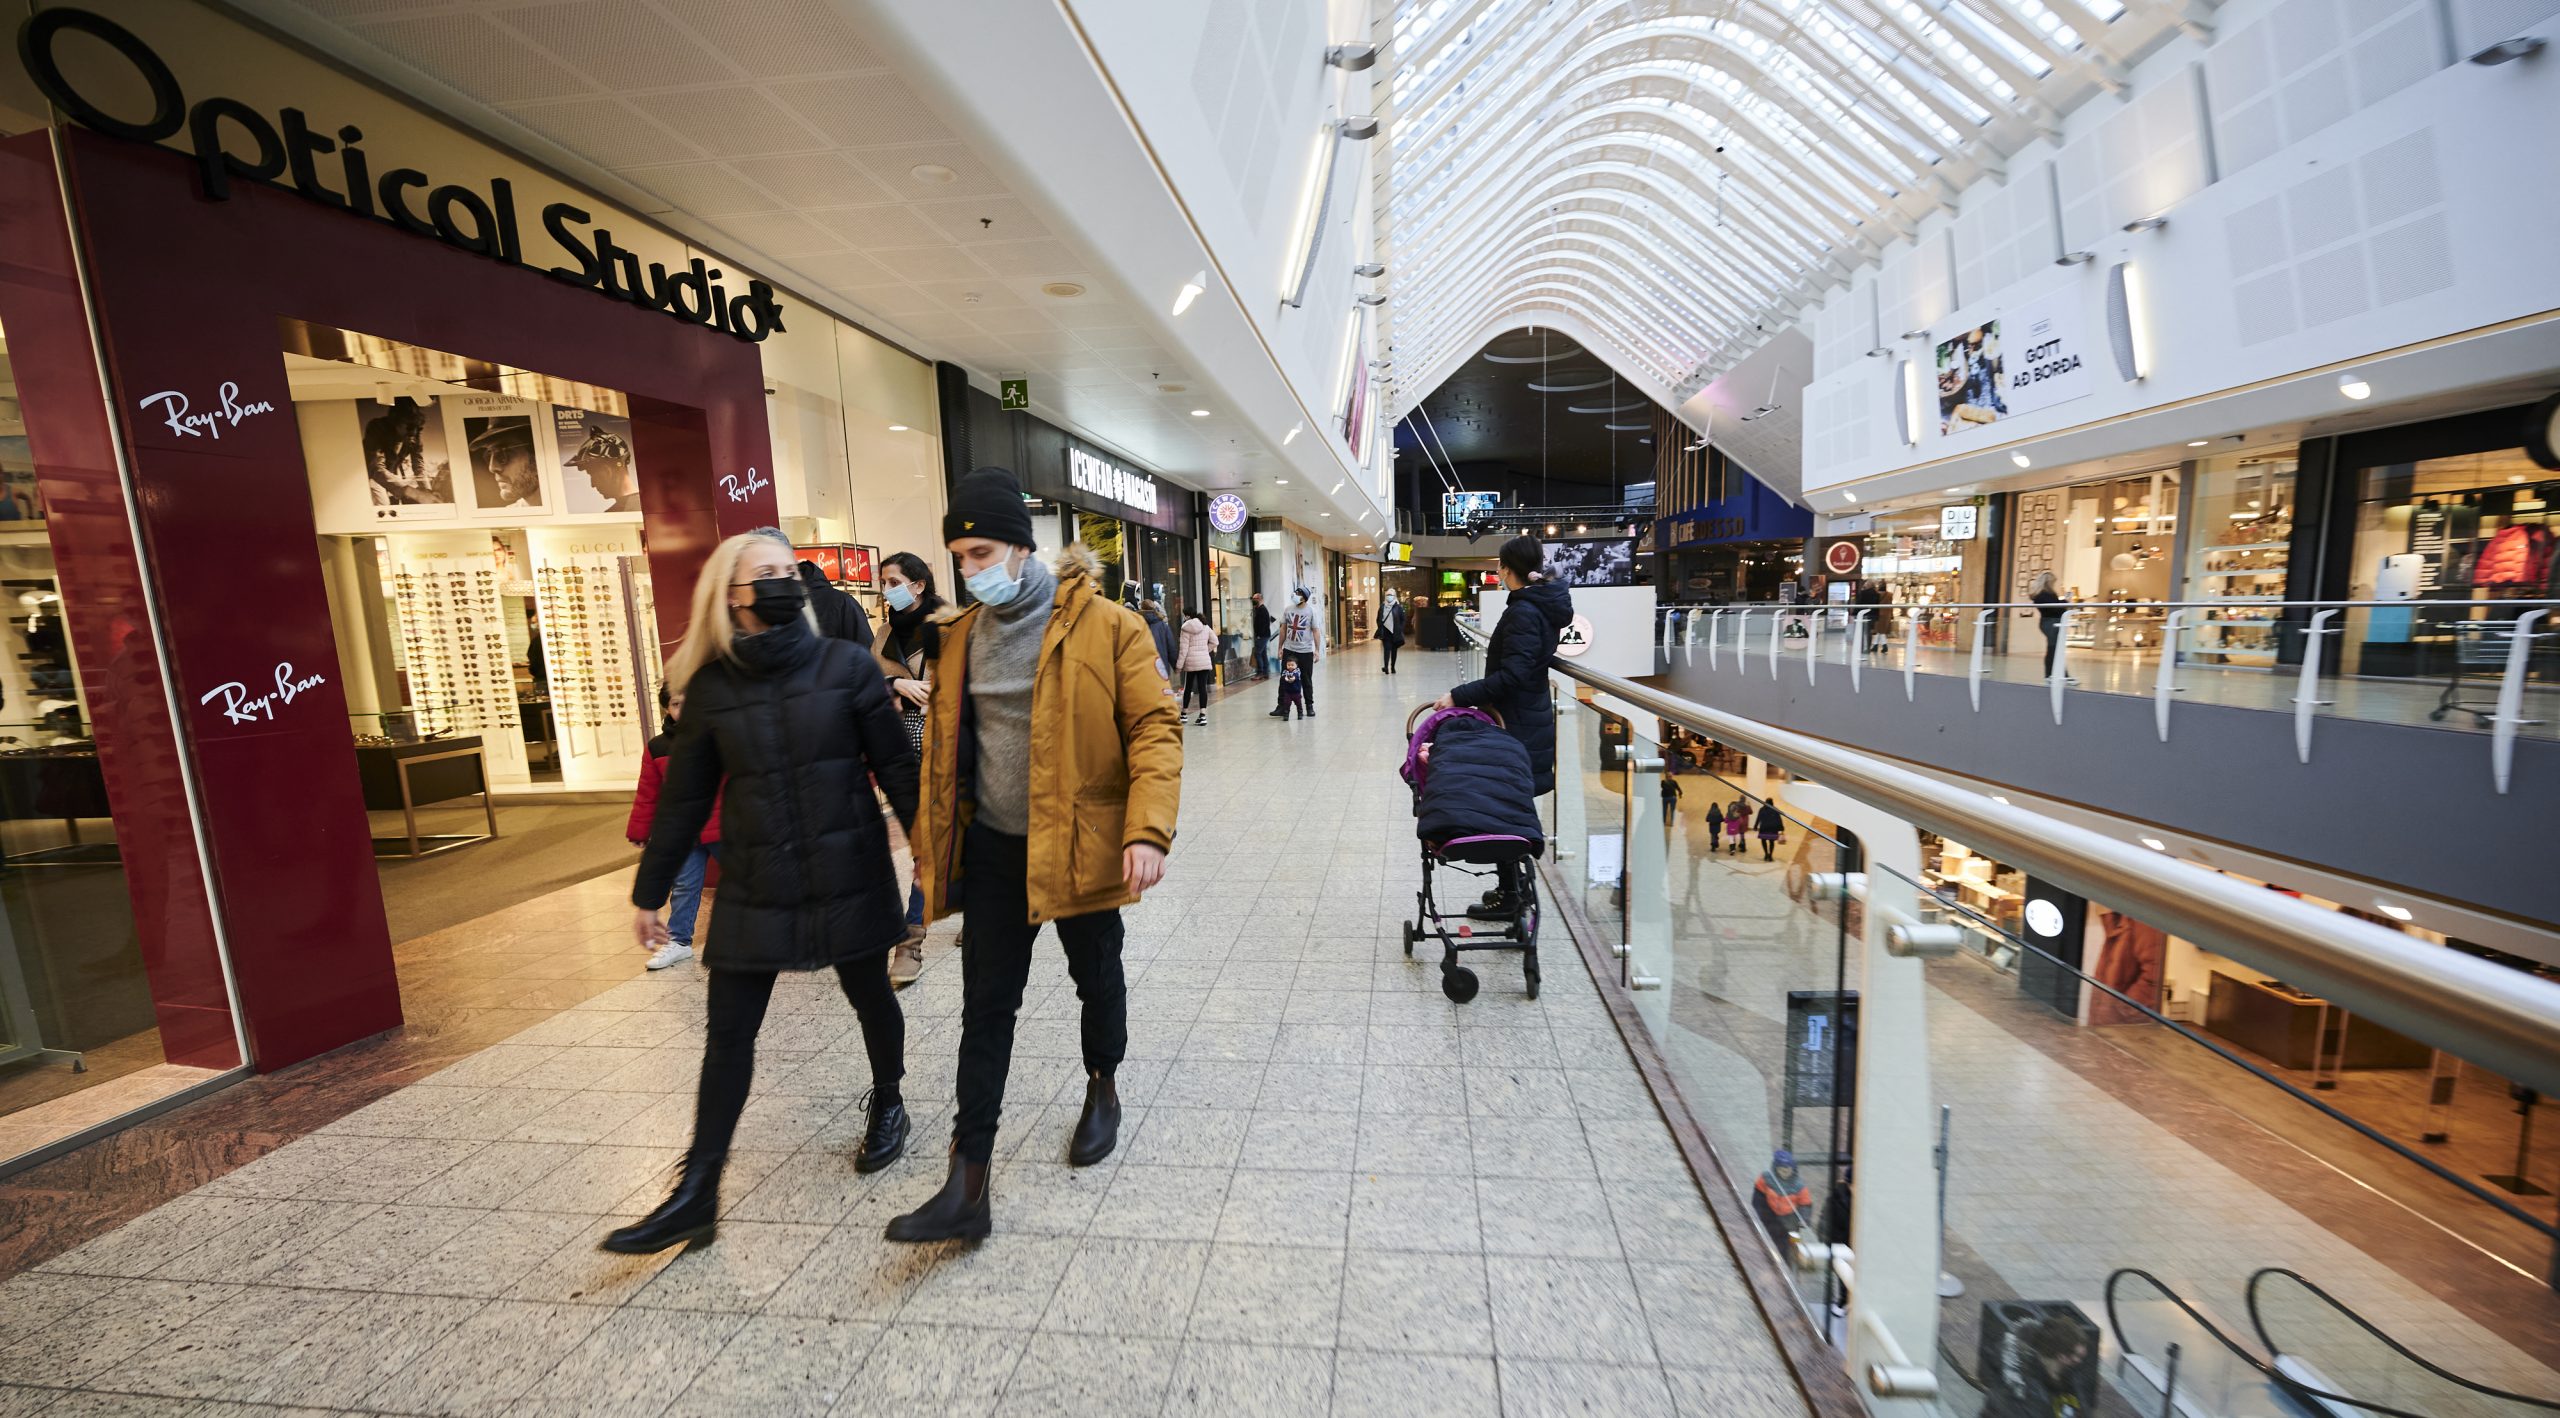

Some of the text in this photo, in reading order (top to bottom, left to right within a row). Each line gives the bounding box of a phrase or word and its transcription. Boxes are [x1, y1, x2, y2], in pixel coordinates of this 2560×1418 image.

[17, 8, 522, 264] Optical
[542, 203, 772, 342] Studio
[2026, 338, 2062, 363] GOTT
[1070, 447, 1114, 500] ICEWEAR
[570, 543, 625, 554] GUCCI
